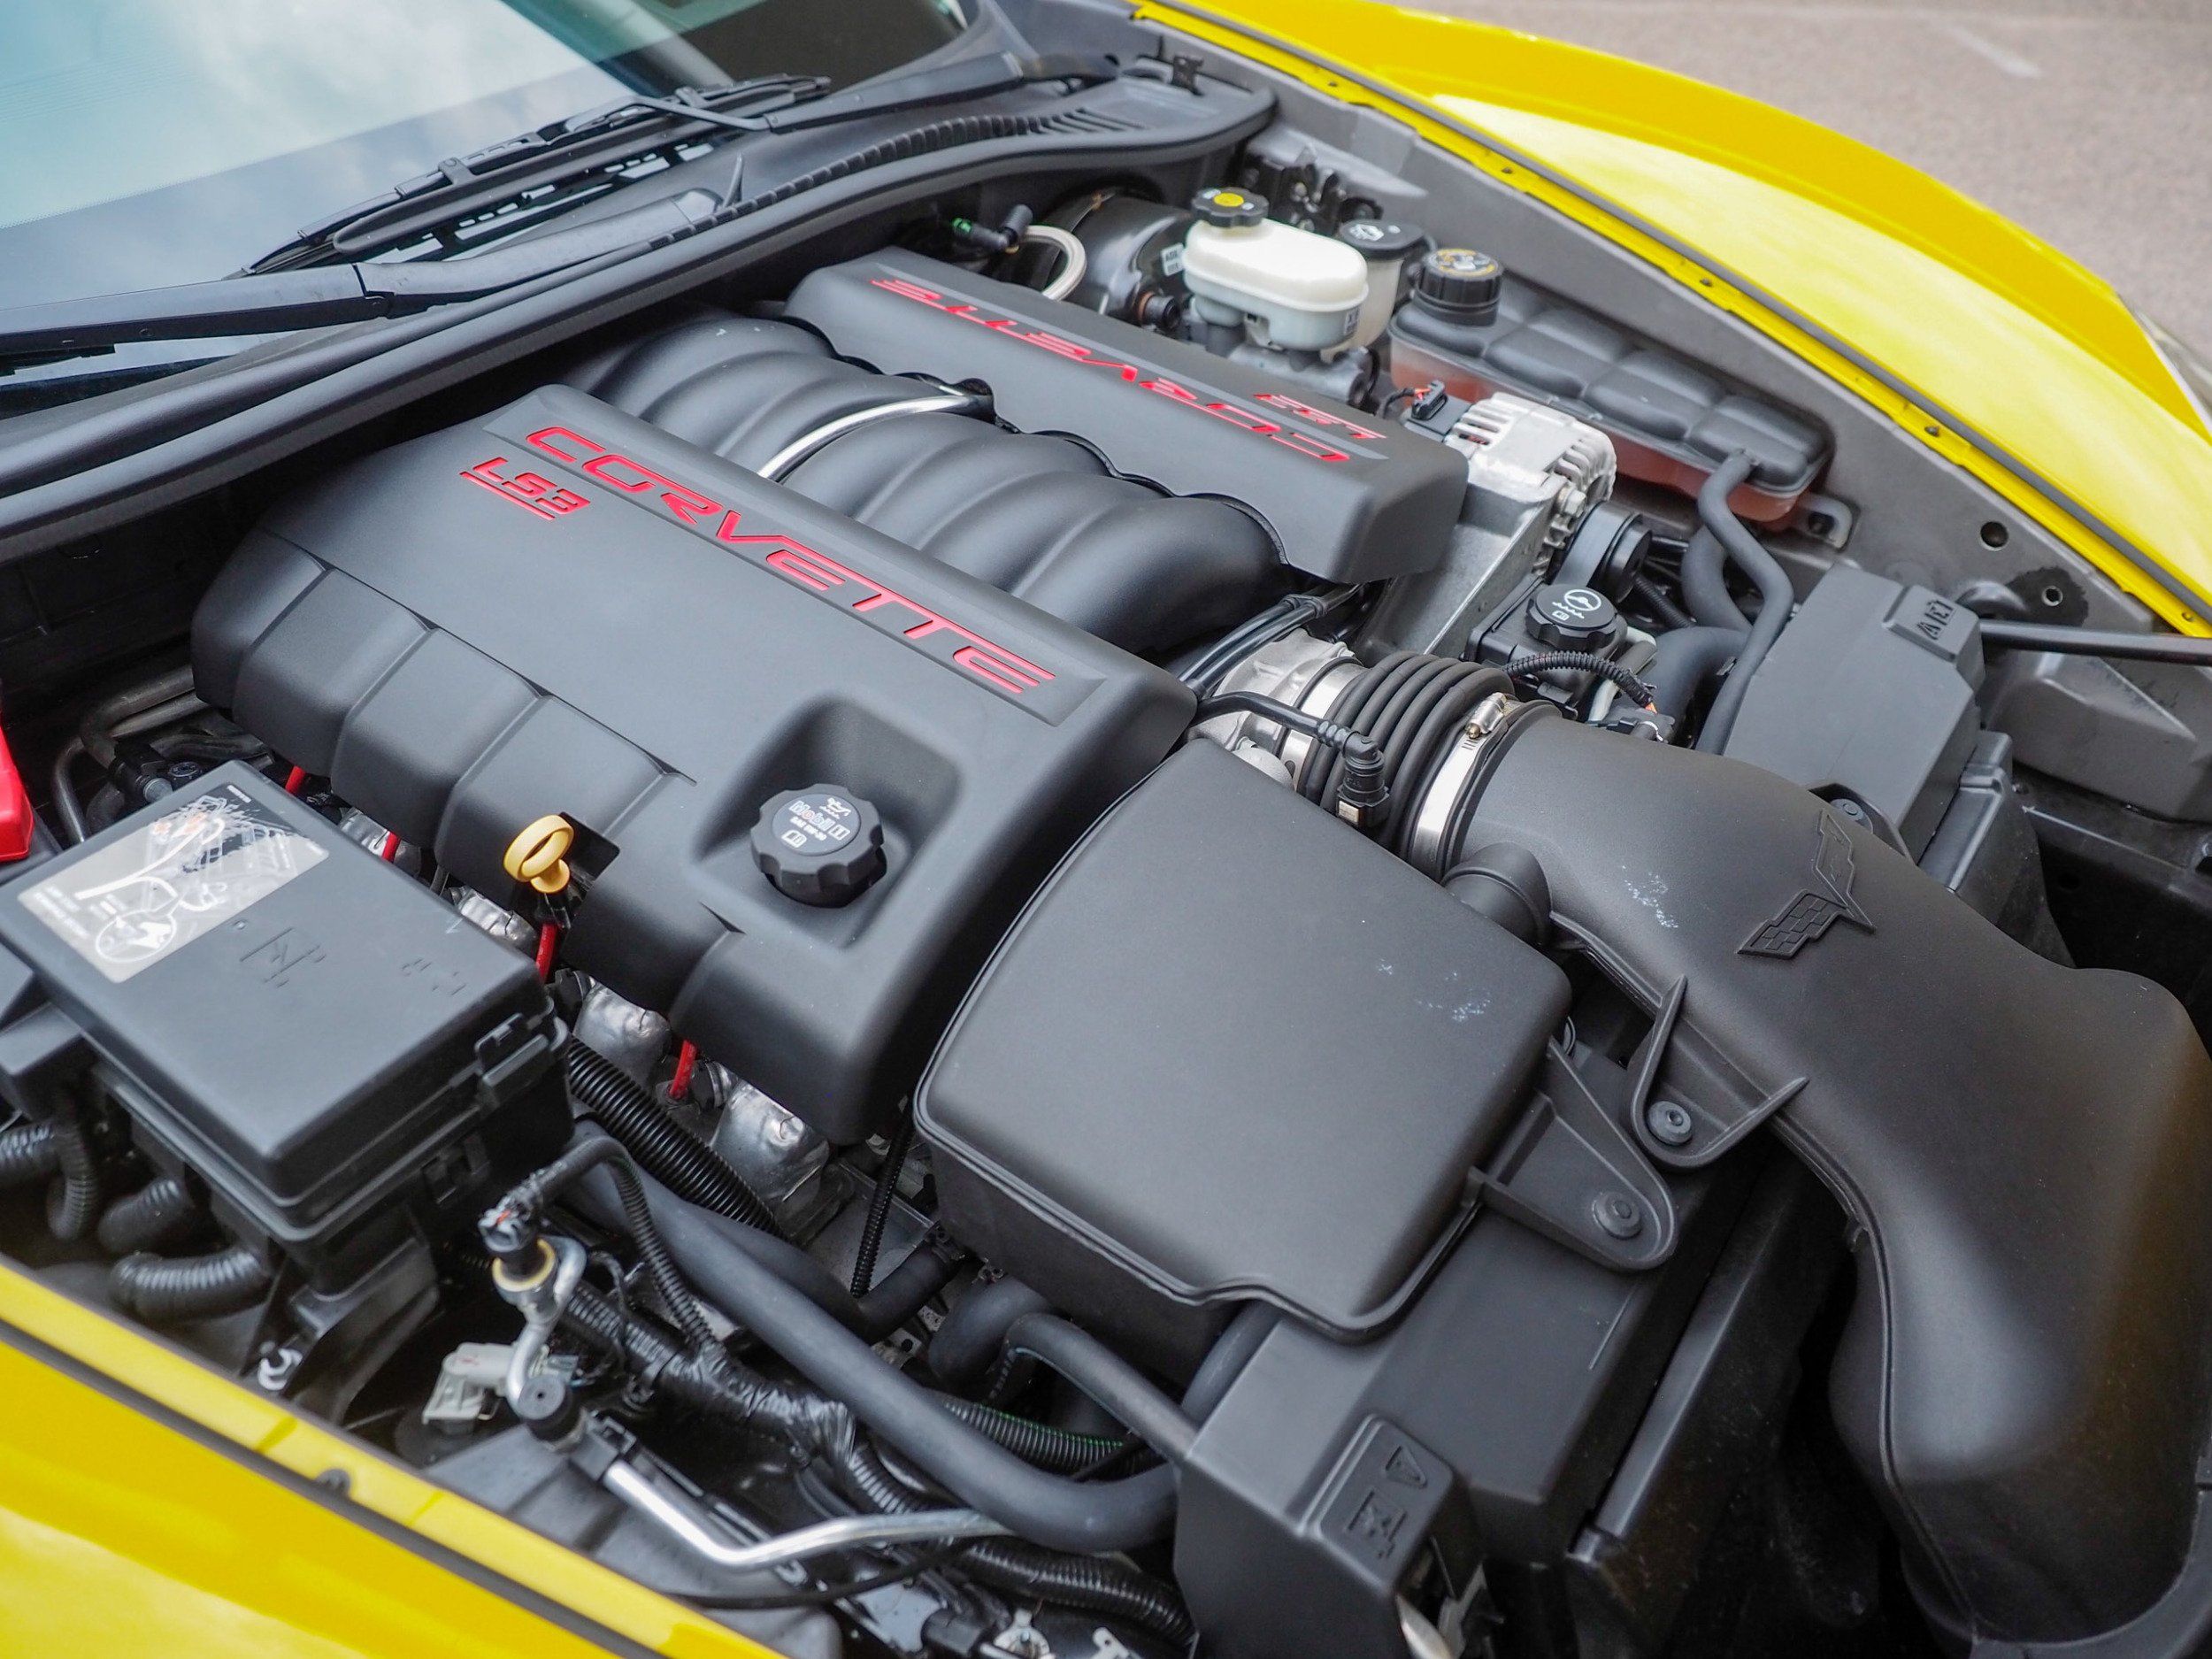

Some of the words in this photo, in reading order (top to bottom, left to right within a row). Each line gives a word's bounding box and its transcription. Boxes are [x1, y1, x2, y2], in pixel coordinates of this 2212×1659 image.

[870, 280, 1350, 463] CORVETTE
[472, 456, 591, 516] LS3
[526, 426, 1056, 695] CORVETTE
[788, 800, 836, 832] Mobil
